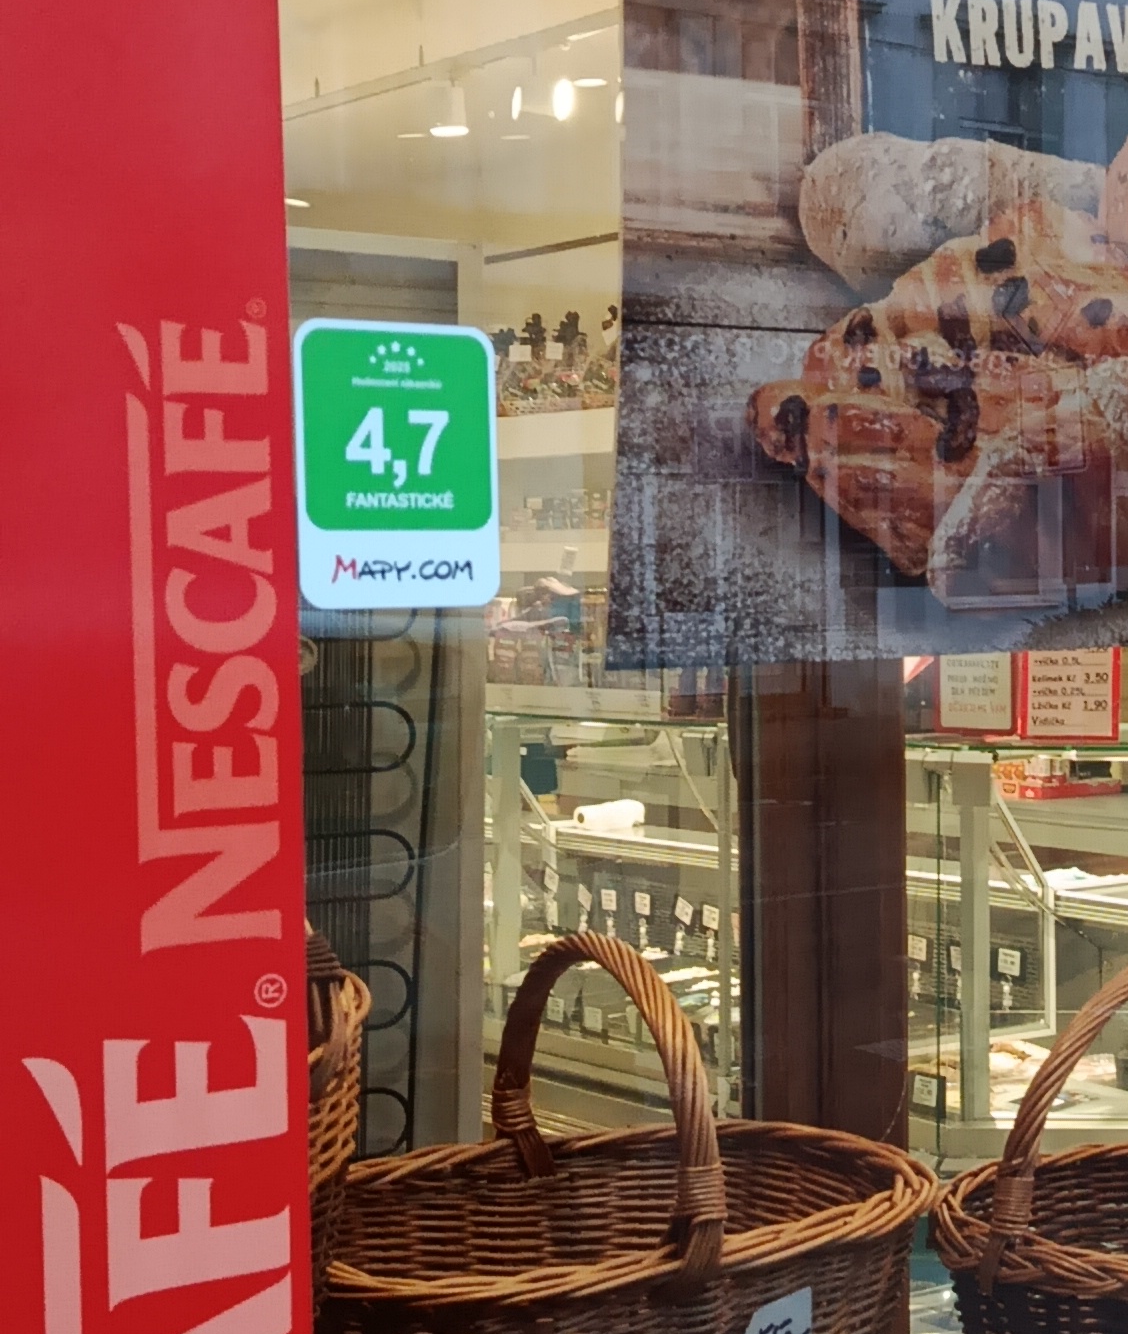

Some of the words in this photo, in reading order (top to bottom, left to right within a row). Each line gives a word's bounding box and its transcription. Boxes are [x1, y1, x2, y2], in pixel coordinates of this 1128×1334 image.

[345, 407, 450, 488] 4,7
[345, 490, 454, 510] FANTASTICKÉ
[116, 319, 284, 957] NESCAFÉ
